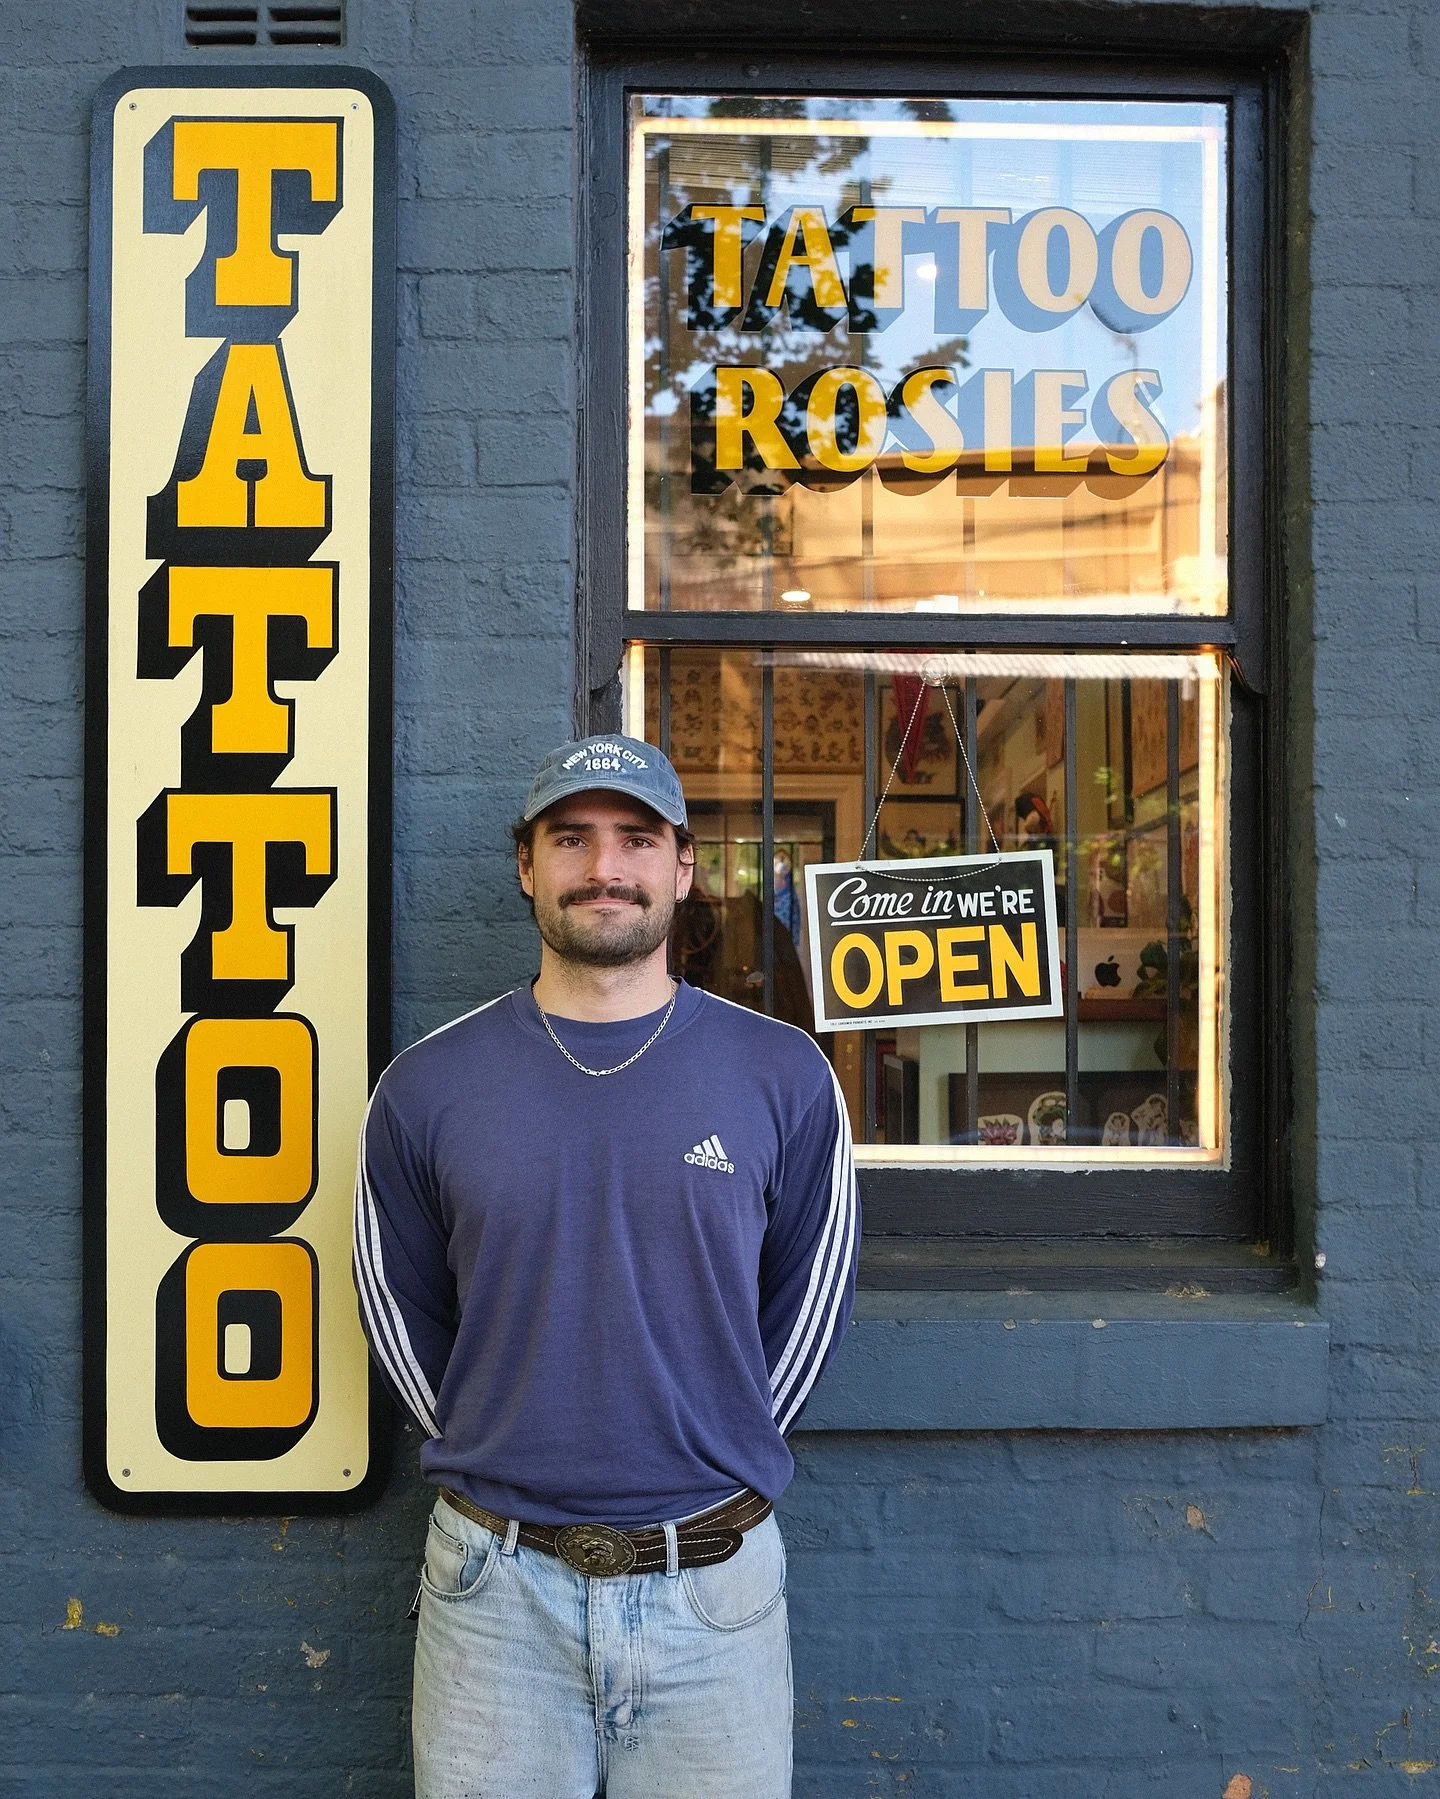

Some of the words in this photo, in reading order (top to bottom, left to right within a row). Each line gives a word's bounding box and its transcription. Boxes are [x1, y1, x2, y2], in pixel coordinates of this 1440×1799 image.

[687, 204, 1193, 316] TATTOO
[713, 365, 1170, 477] ROSIES
[164, 120, 341, 1430] TATTOO
[562, 749, 588, 770] NEW
[588, 743, 624, 757] YORK
[622, 750, 649, 769] CITY
[827, 877, 914, 918] Come
[921, 885, 955, 914] in
[957, 885, 1036, 918] WE'RE
[830, 922, 1042, 1009] OPEN
[683, 1152, 735, 1174] adidas
